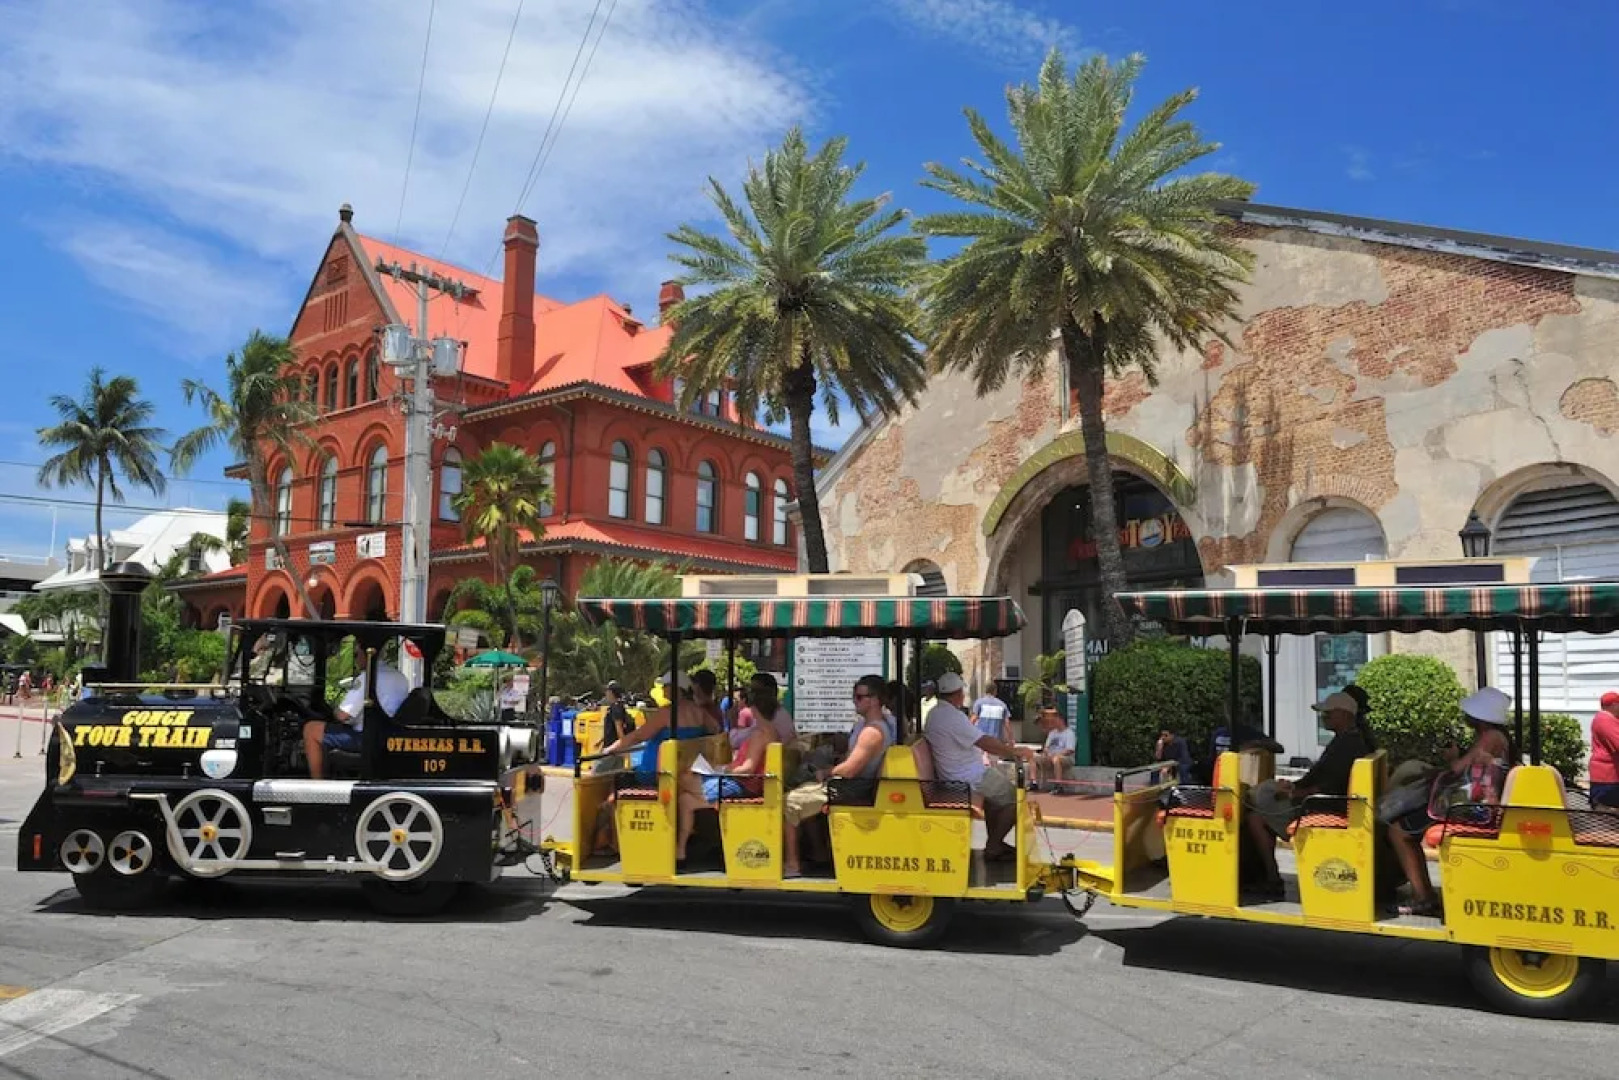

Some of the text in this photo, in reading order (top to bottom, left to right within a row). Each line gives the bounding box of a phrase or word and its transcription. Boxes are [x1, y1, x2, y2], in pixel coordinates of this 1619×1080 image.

[122, 711, 194, 726] CONCH
[74, 725, 133, 747] TOUR
[138, 727, 212, 748] TRAIN
[386, 737, 454, 752] OVERSEAS
[423, 759, 446, 772] 109
[633, 809, 651, 819] KEY
[629, 820, 654, 831] WEST
[1174, 827, 1224, 842] BIG PINE
[1186, 842, 1208, 855] KEY
[846, 854, 956, 873] OVERSEAS R.R.
[1463, 899, 1616, 931] OVERSEAS R.R.
